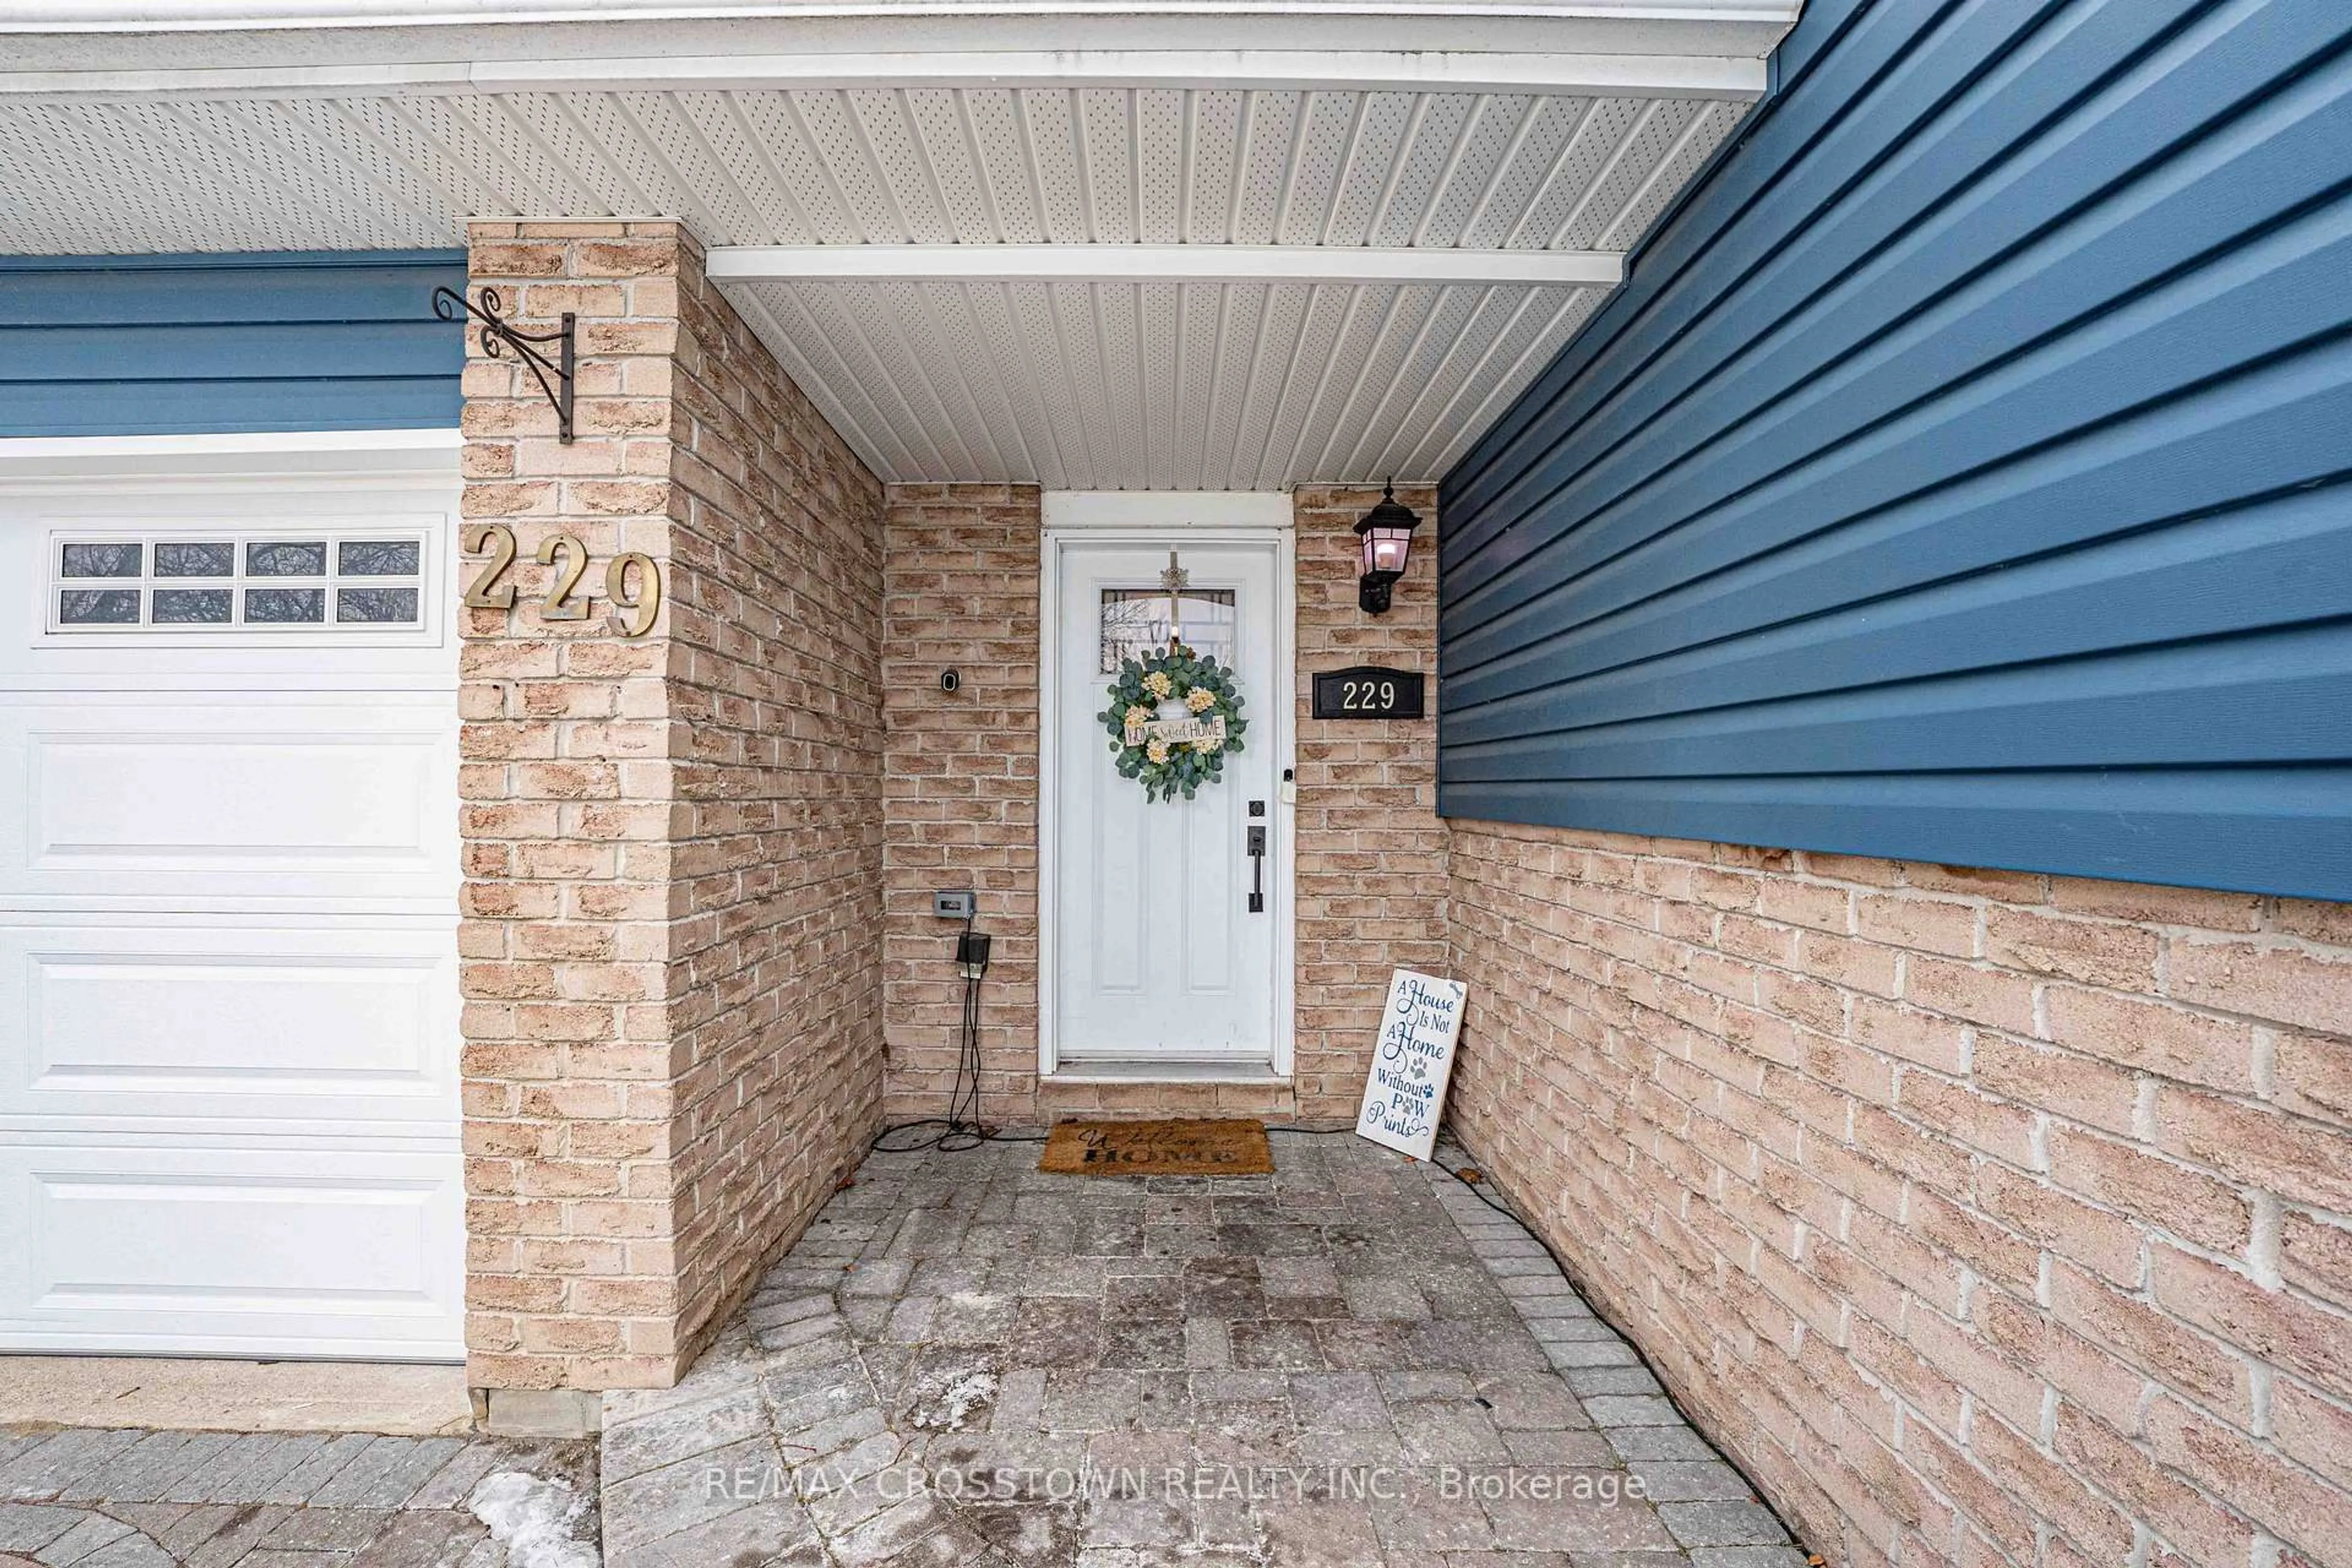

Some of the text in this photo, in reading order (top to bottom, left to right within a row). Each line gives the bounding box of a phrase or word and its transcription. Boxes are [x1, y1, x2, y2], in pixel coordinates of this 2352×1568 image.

[465, 524, 661, 638] 229
[1343, 682, 1395, 709] 229
[1189, 720, 1221, 739] HOME
[1396, 979, 1454, 1026] A House
[1420, 1012, 1450, 1034] Is Not
[1383, 1022, 1445, 1074] A Home
[1378, 1068, 1423, 1096] Without
[1366, 1101, 1429, 1138] Prints
